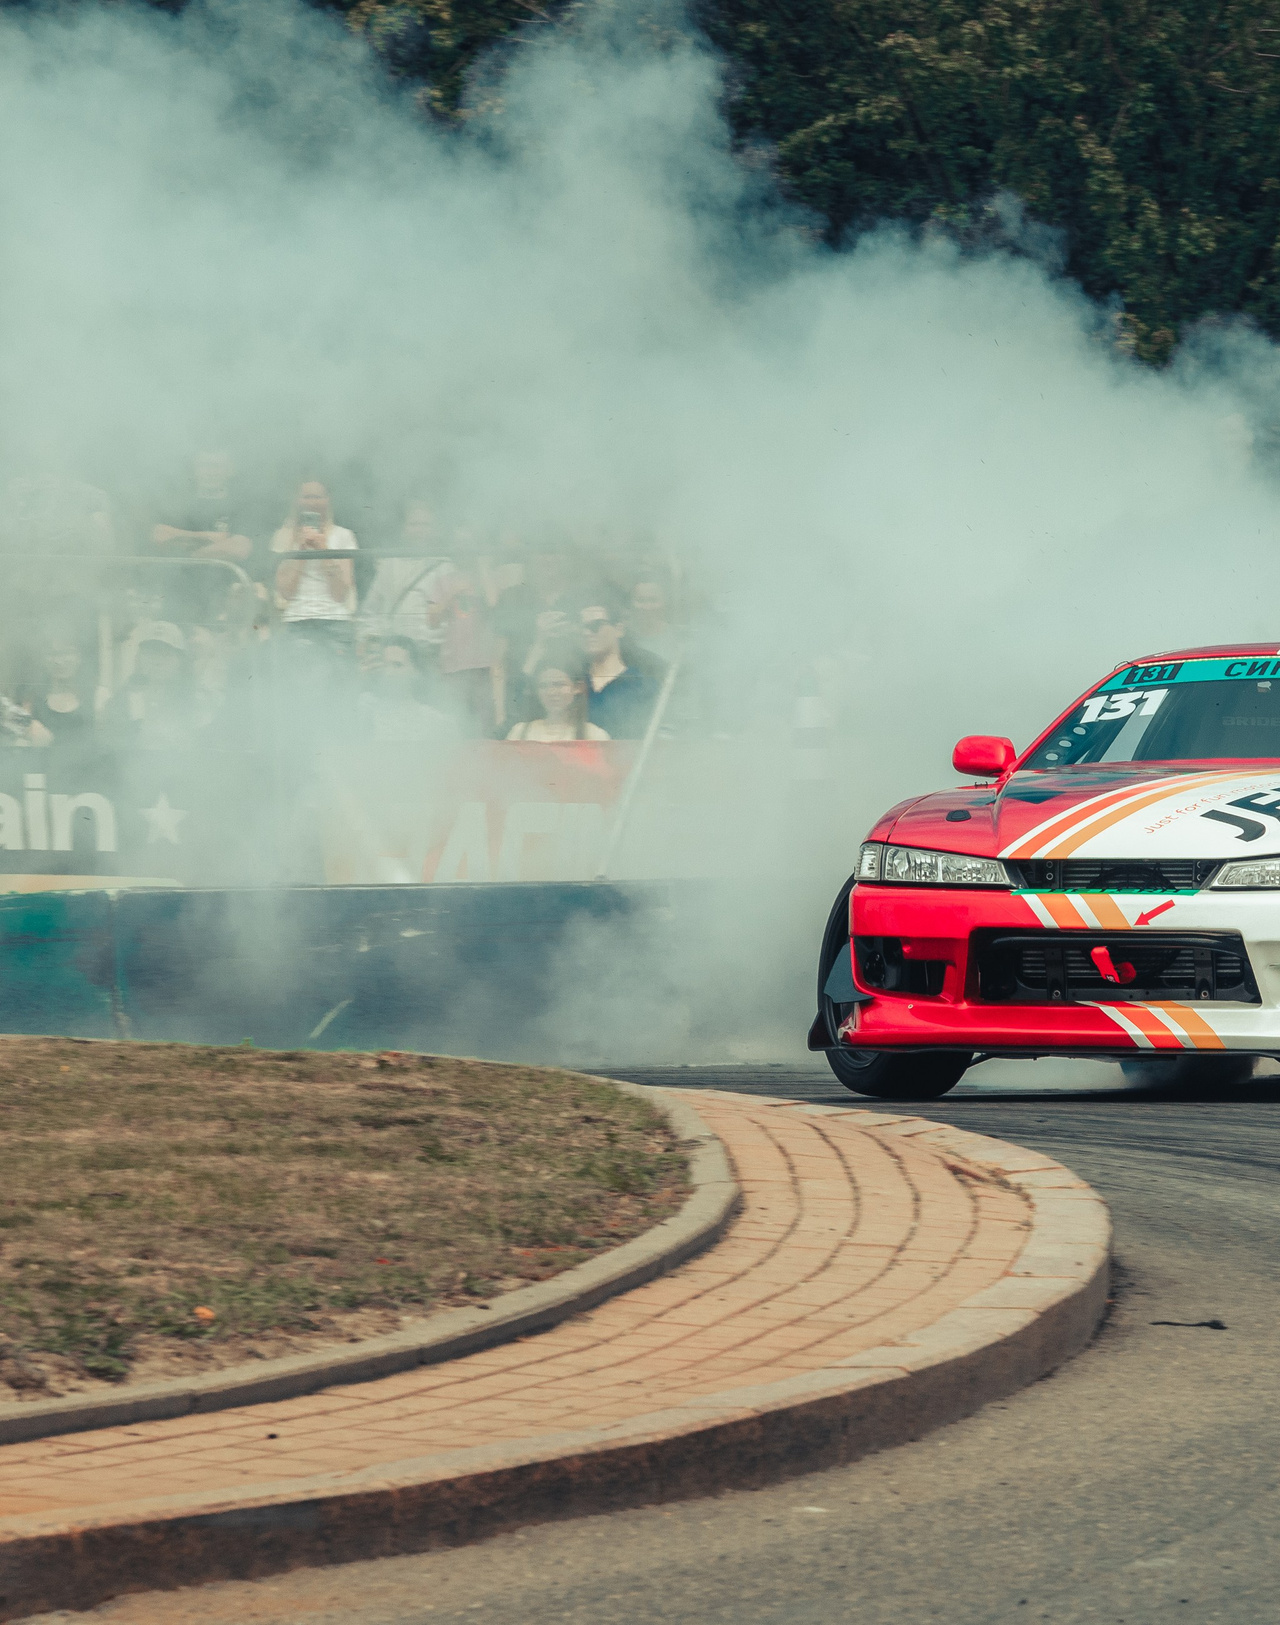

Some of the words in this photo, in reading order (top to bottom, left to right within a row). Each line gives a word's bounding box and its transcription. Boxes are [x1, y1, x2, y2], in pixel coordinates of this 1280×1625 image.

[1132, 664, 1176, 683] 131
[1080, 689, 1169, 724] 131
[1144, 815, 1179, 833] Just
[1175, 803, 1201, 815] for
[1200, 793, 1230, 803] fun
